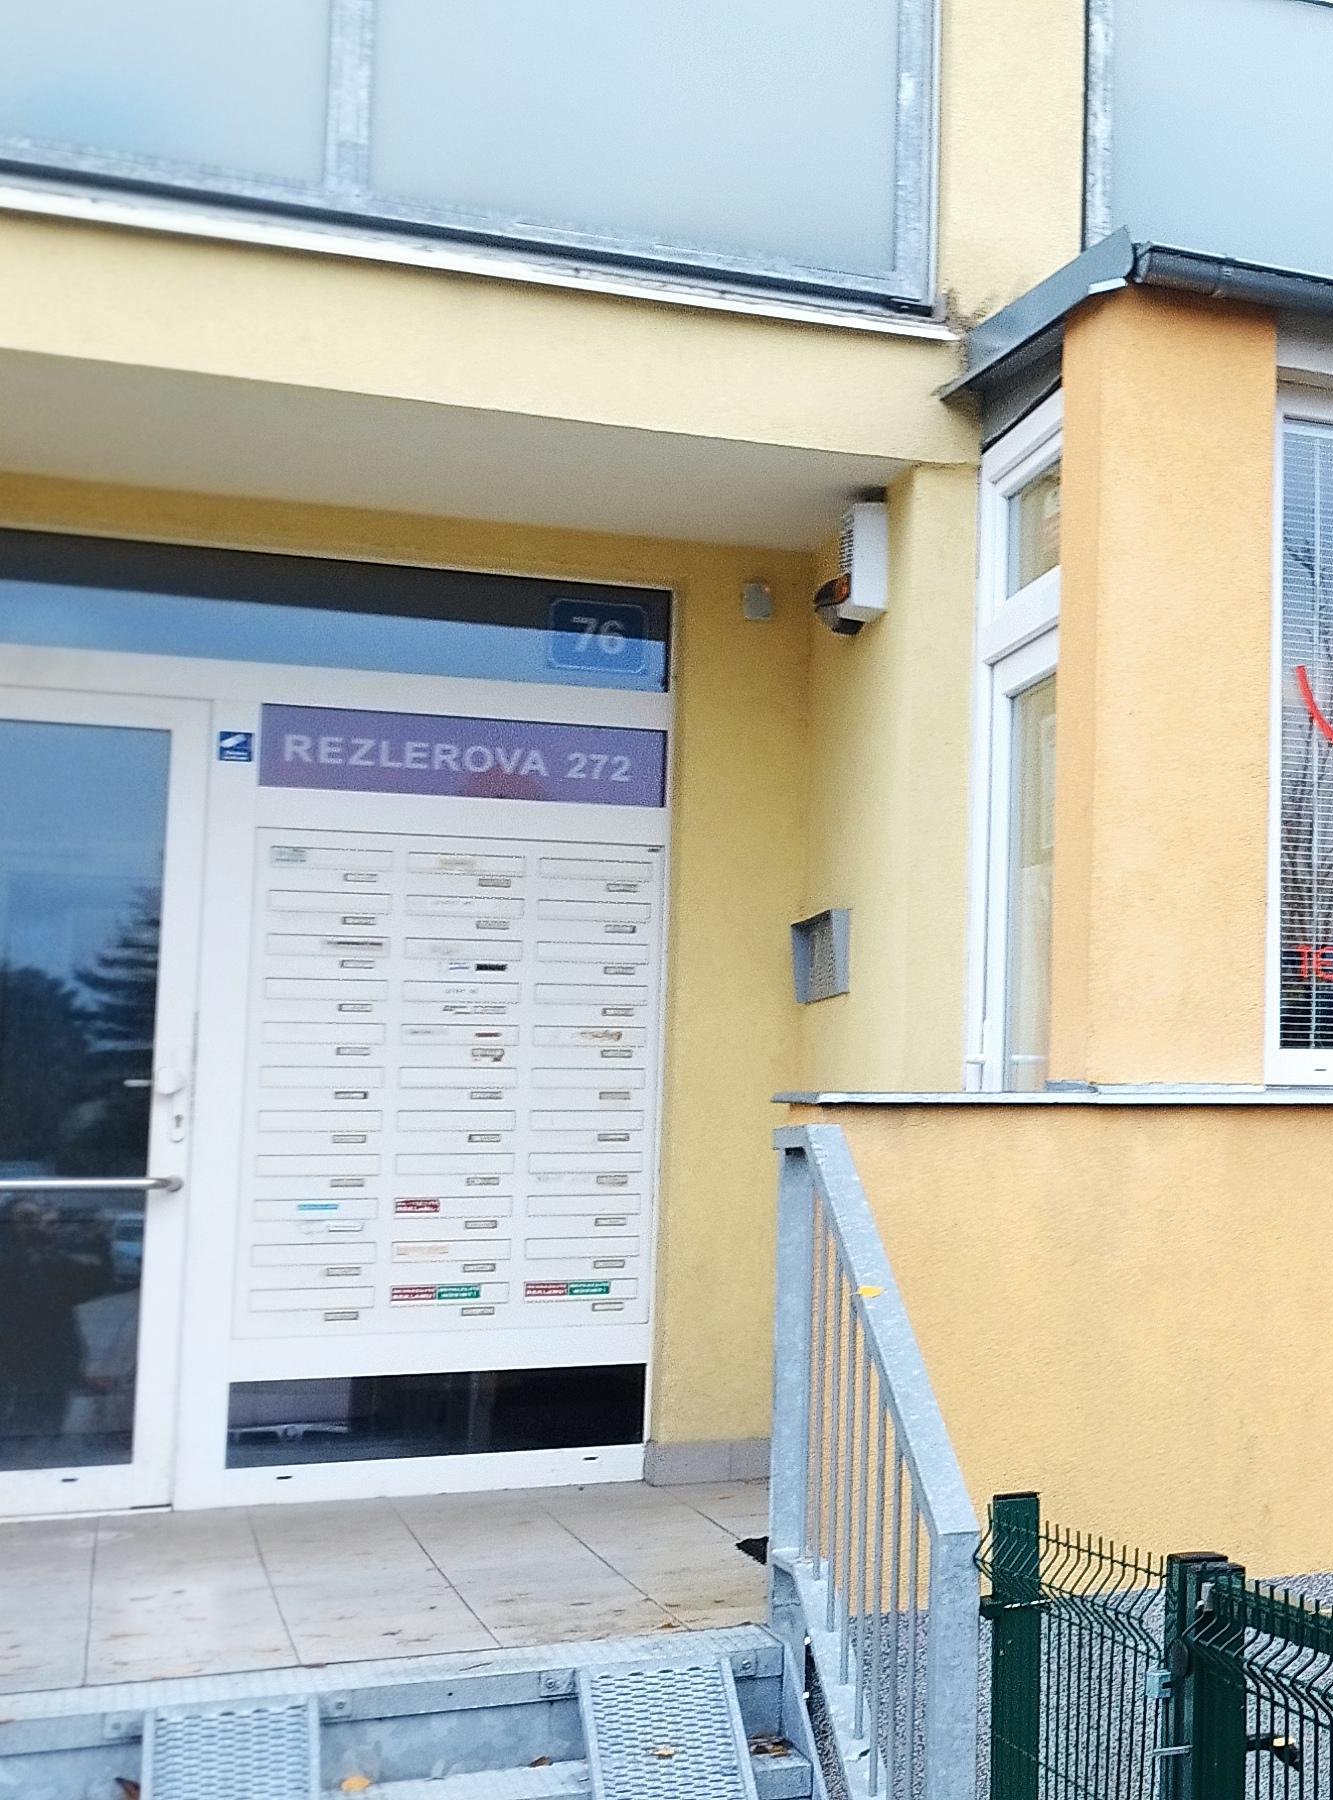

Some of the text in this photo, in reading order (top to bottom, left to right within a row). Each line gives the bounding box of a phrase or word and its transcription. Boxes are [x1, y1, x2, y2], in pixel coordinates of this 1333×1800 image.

[572, 616, 625, 655] 76
[284, 734, 632, 783] REZLEROVA 272
